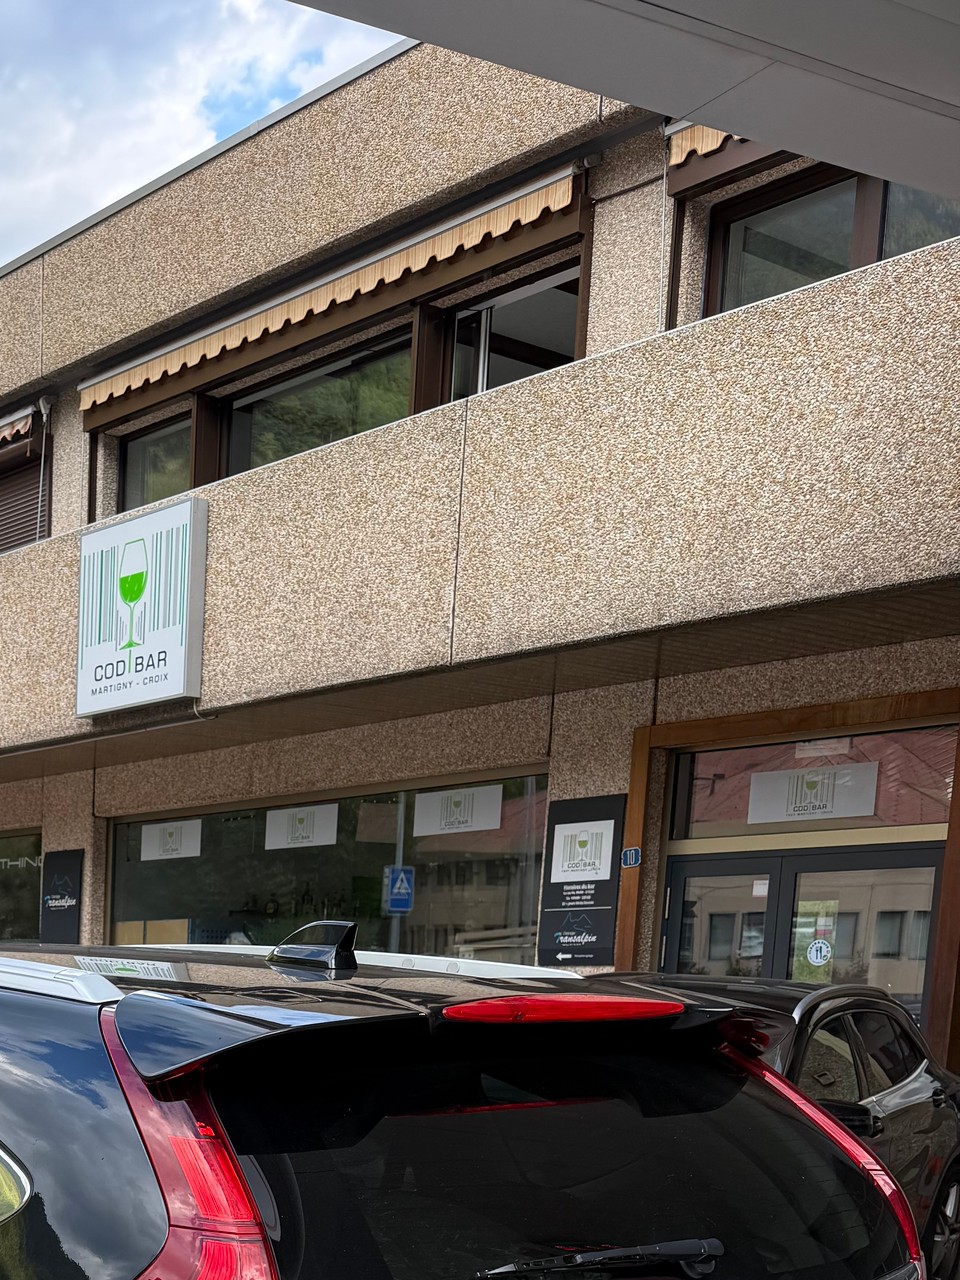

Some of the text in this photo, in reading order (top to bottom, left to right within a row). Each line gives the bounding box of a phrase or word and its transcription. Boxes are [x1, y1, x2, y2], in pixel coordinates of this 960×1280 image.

[90, 680, 134, 697] MARTIGNY
[142, 672, 169, 686] CROIX
[626, 850, 636, 865] 10
[553, 931, 597, 945] Transalpin
